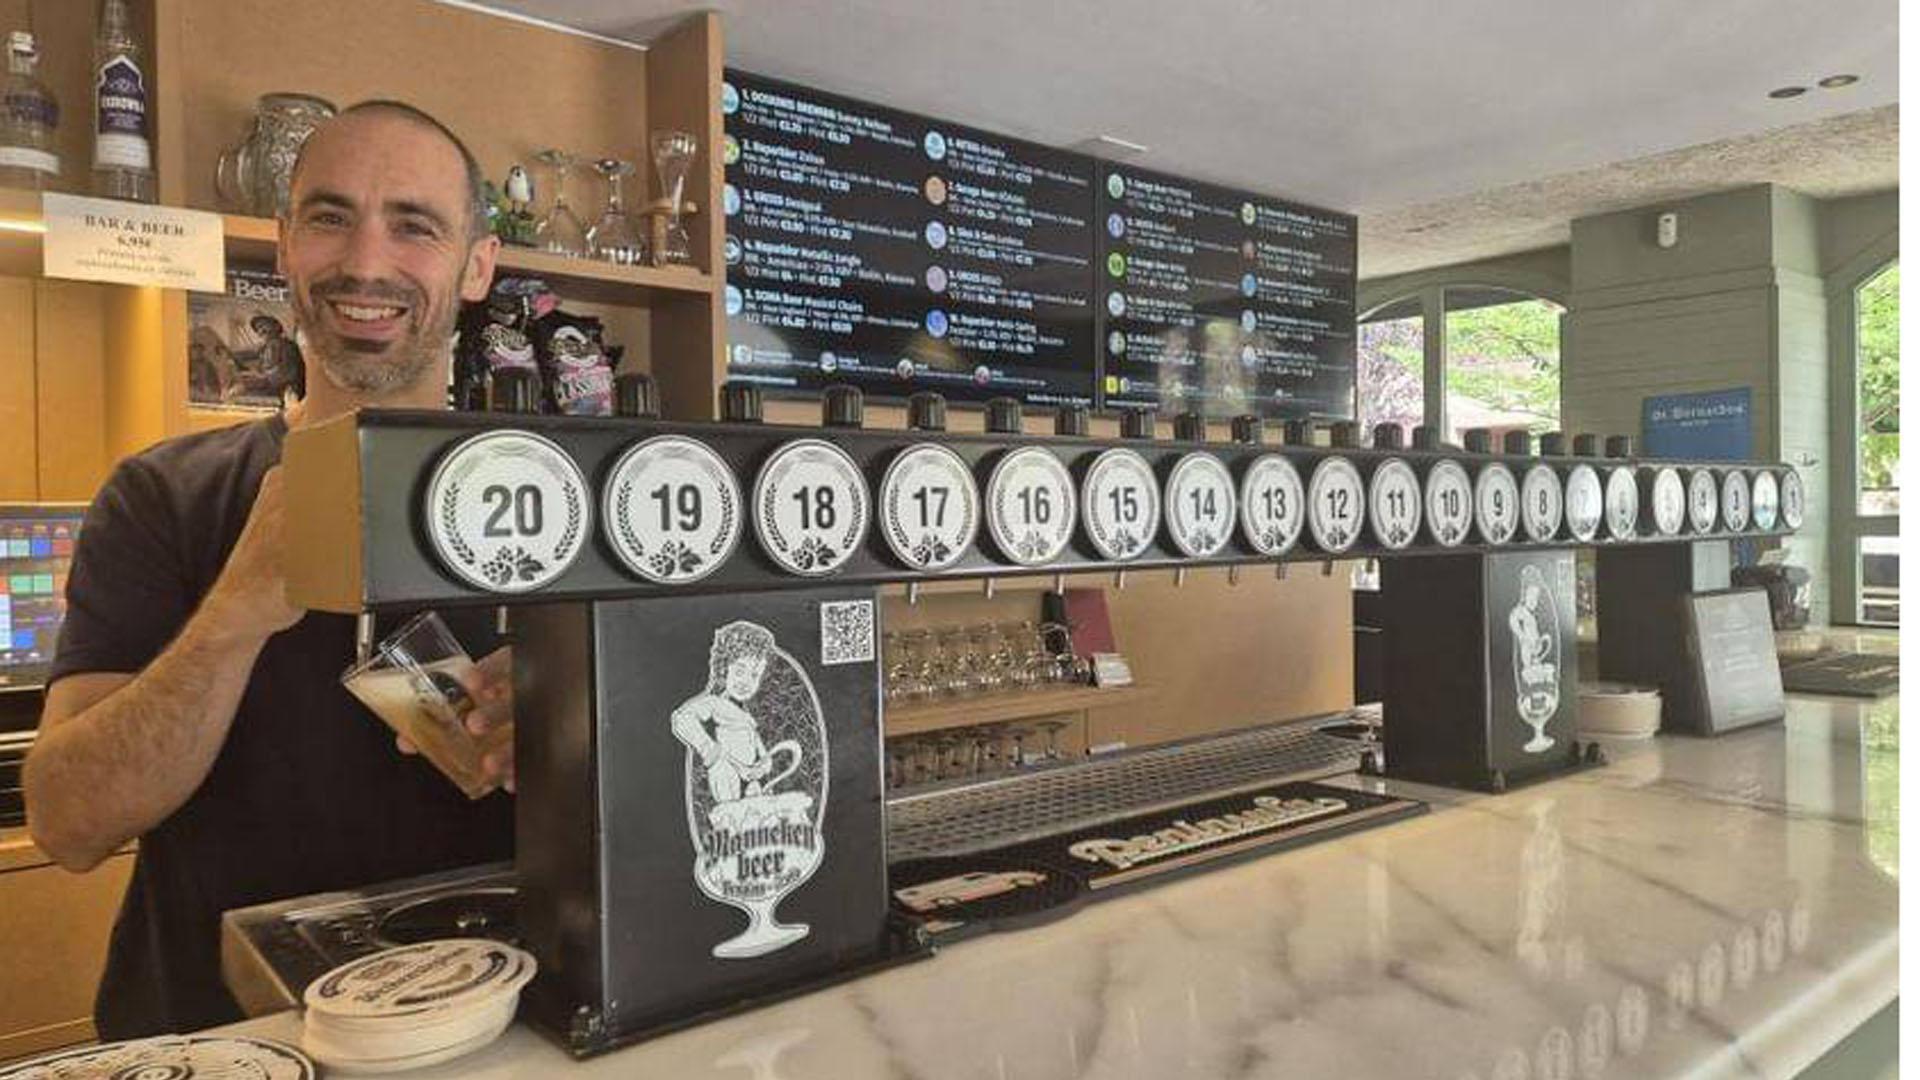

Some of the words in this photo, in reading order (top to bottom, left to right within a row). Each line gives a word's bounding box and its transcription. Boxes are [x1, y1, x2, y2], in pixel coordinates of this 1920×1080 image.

[141, 222, 185, 236] BEER
[235, 279, 288, 302] Beer
[482, 484, 543, 539] 20
[651, 484, 702, 532] 19
[792, 486, 836, 531] 18
[913, 487, 949, 528] 17
[1017, 486, 1050, 524] 16
[1108, 487, 1138, 523] 15
[1190, 488, 1217, 522] 14
[1262, 488, 1287, 520] 13
[1327, 489, 1348, 519] 12
[1387, 489, 1407, 518] 11
[1440, 489, 1460, 517] 10
[1493, 489, 1502, 517] 9
[1539, 489, 1548, 516] 8
[701, 817, 815, 871] Manneken
[738, 850, 785, 881] beer
